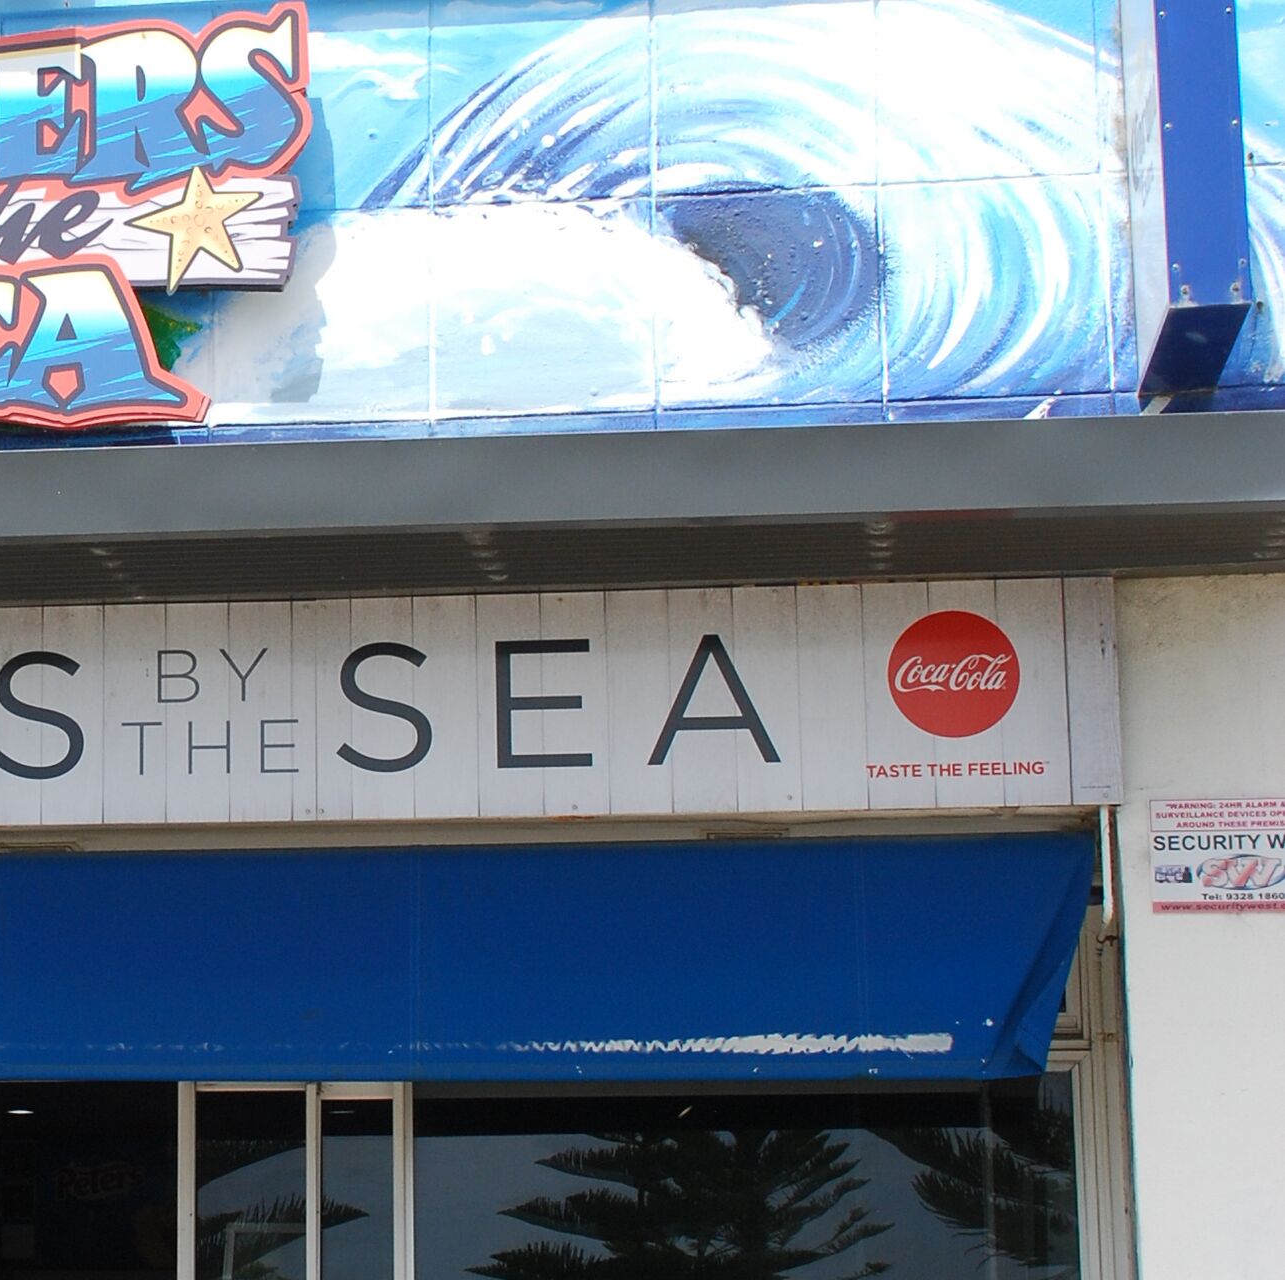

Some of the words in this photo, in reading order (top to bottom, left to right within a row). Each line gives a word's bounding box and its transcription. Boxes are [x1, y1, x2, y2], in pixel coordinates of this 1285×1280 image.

[156, 647, 269, 705] BY
[894, 653, 1013, 693] Coca-Cola
[335, 633, 783, 775] SEA
[120, 718, 300, 777] THE
[866, 764, 923, 779] TASTE
[927, 763, 963, 778] THE
[968, 761, 1045, 776] FEELING
[1245, 801, 1277, 809] ALARM
[1155, 811, 1225, 819] SURVEILLANCE
[1227, 810, 1267, 818] DEVICES
[1175, 821, 1216, 829] AROUND
[1219, 820, 1247, 828] THESE
[1153, 834, 1261, 852] SECURITY
[1201, 893, 1222, 901] Tel:
[1225, 892, 1254, 901] 9328
